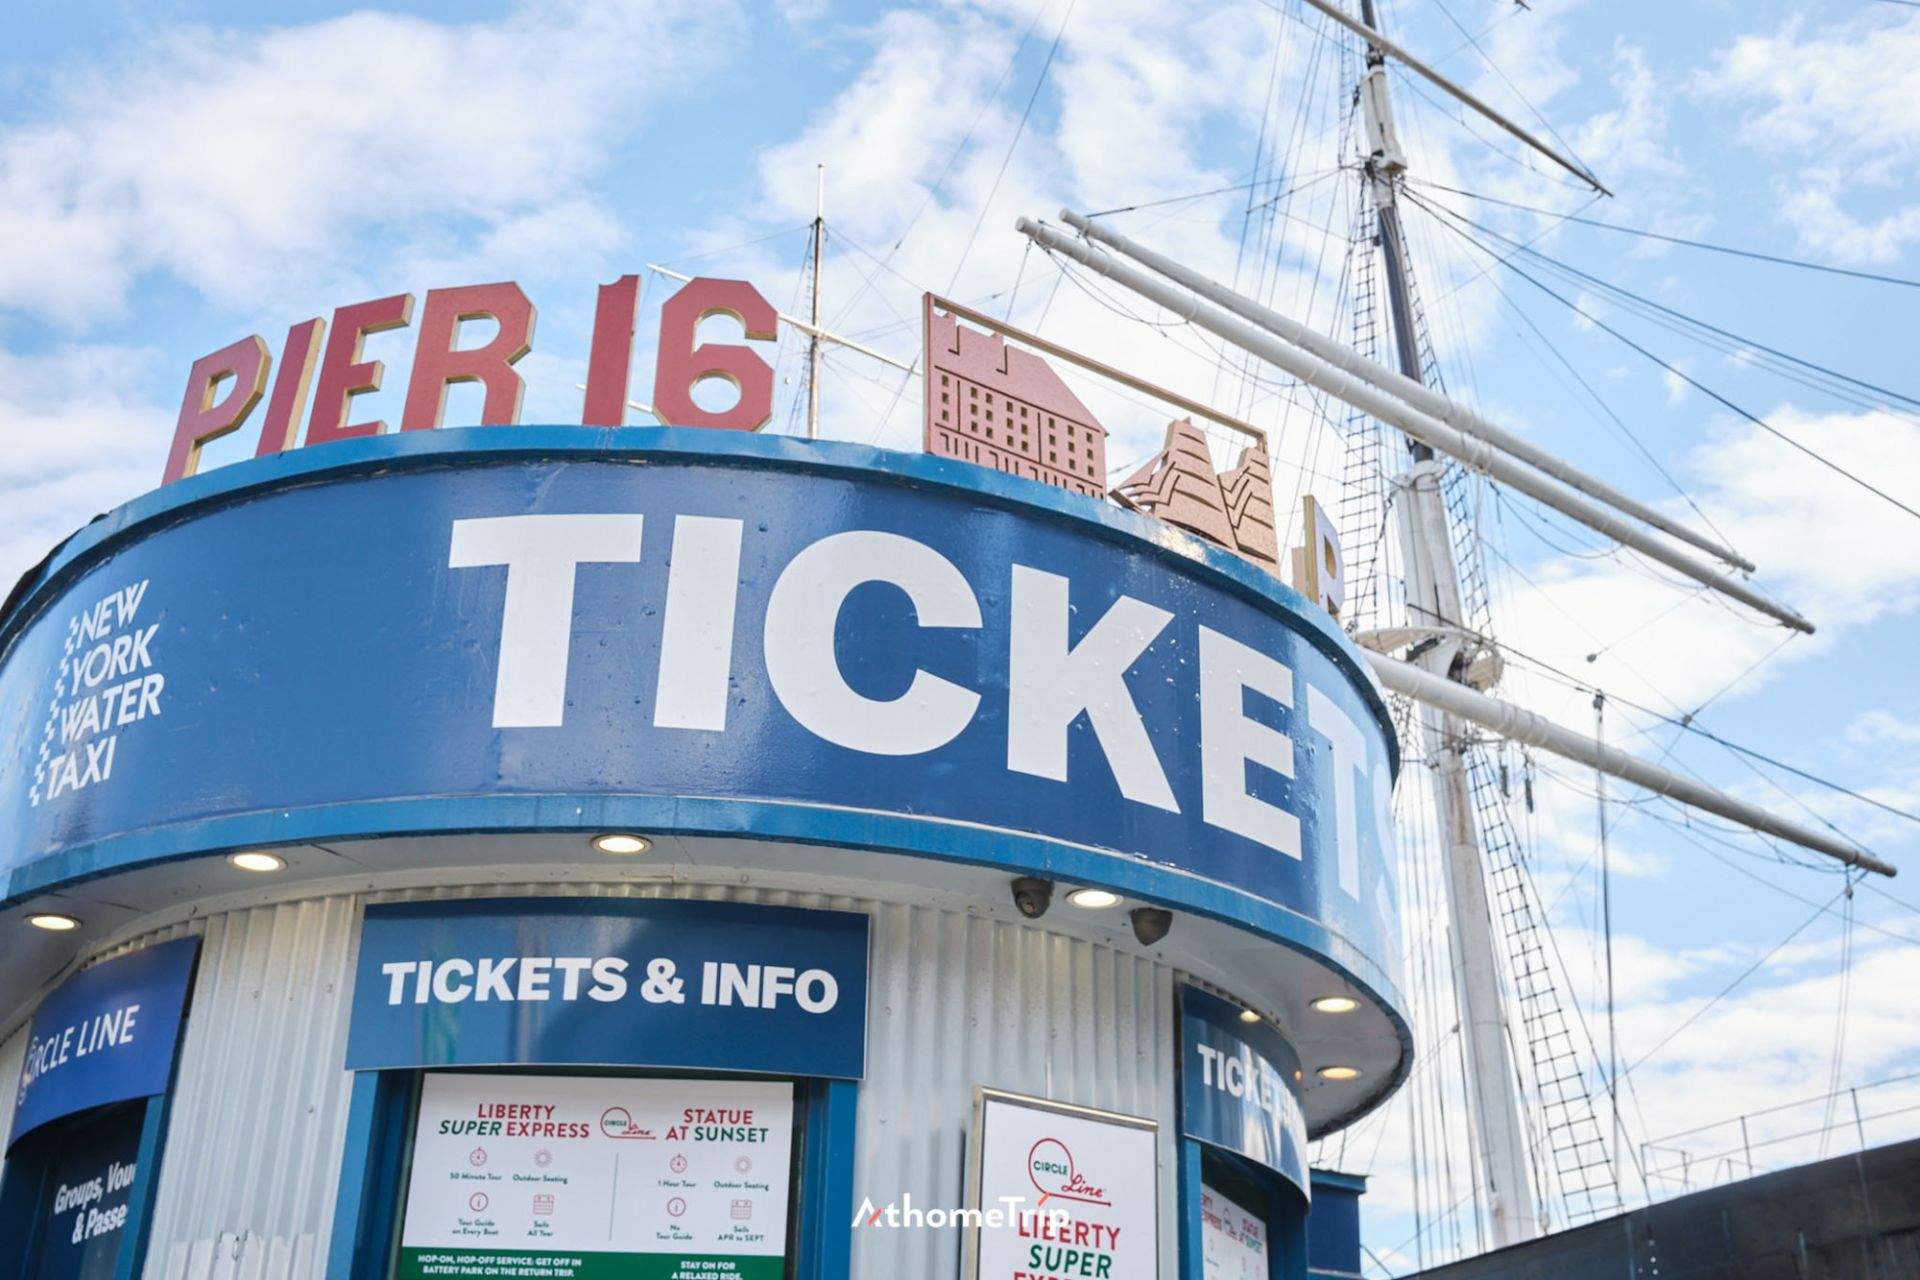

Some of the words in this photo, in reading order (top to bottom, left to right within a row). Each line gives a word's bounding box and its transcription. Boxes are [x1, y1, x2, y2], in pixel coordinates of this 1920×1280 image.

[162, 280, 538, 487] PIER
[581, 274, 778, 432] 16
[76, 579, 149, 649] NEW
[71, 623, 160, 696] YORK
[61, 673, 165, 745] WATER
[46, 735, 117, 801] TAXI
[382, 957, 630, 1005] TICKETS
[640, 957, 685, 1004] &
[701, 961, 838, 1014] INFO
[76, 1004, 140, 1057] LINE
[478, 1103, 556, 1120] LIBERTY
[683, 1108, 754, 1125] STATUE
[438, 1119, 502, 1137] SUPER
[506, 1121, 590, 1139] EXPRESS
[603, 1118, 627, 1127] CIRCLE
[665, 1125, 689, 1141] AT
[694, 1127, 769, 1143] SUNSET
[461, 1173, 486, 1181] Minute
[1033, 1160, 1068, 1176] CIRCLE
[512, 1173, 541, 1182] Outdoor
[543, 1174, 568, 1185] Seating
[714, 1180, 741, 1188] Outdoor
[744, 1181, 769, 1191] Seating
[1061, 1174, 1103, 1197] Line
[54, 1176, 104, 1215] Groups,
[72, 1211, 84, 1244] &
[475, 1219, 495, 1227] Guide
[418, 1254, 455, 1265] HOP-ON,
[457, 1255, 495, 1265] HOP-OFF
[535, 1257, 552, 1266] GET
[553, 1258, 570, 1266] OFF
[571, 1258, 582, 1267] IN
[681, 1260, 701, 1269] STAY
[702, 1261, 716, 1270] ON
[717, 1261, 736, 1270] FOR
[1028, 1243, 1112, 1279] SUPER
[422, 1264, 460, 1275] BATTERY
[460, 1265, 483, 1275] PARK
[484, 1266, 499, 1275] ON
[499, 1266, 517, 1276] THE
[518, 1267, 553, 1277] RETURN
[680, 1271, 719, 1280] RELAXED
